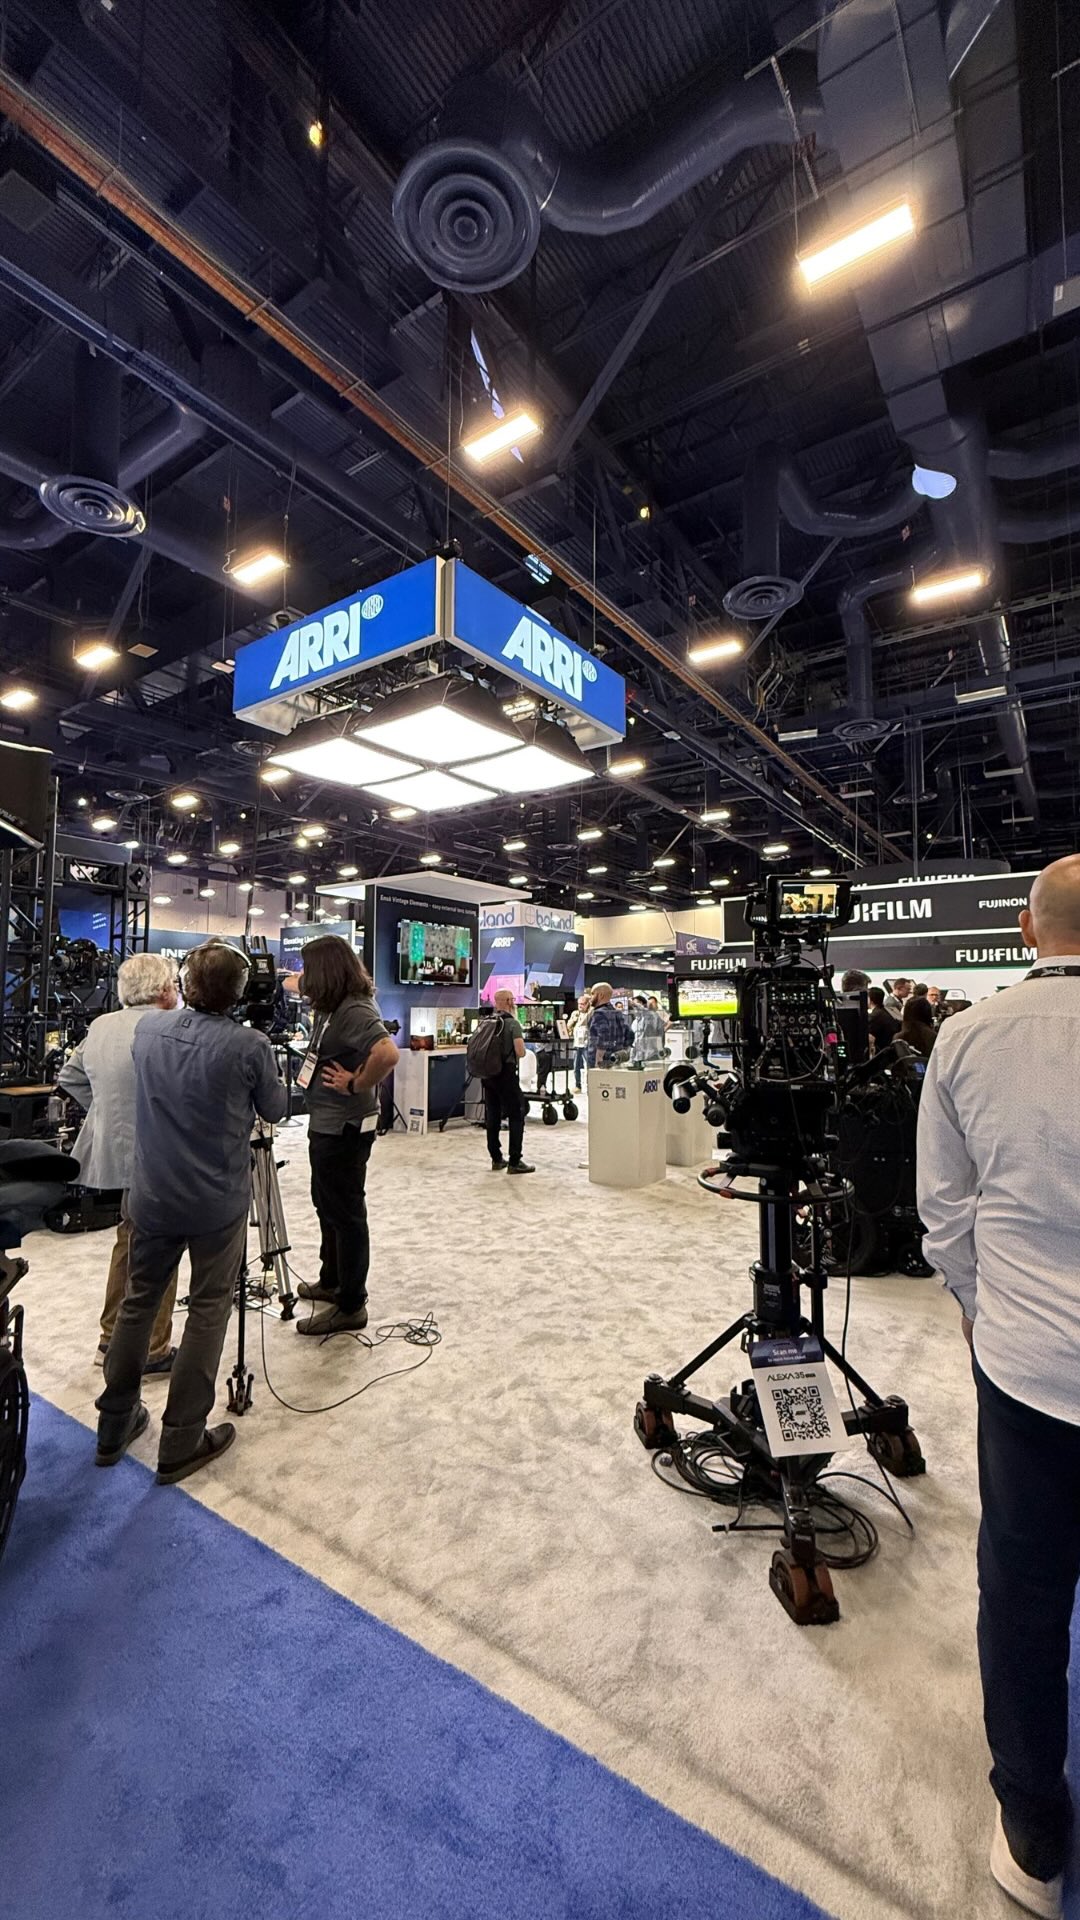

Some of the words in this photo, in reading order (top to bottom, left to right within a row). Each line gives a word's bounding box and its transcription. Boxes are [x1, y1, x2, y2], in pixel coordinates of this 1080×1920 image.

[269, 601, 361, 690] ARRI
[501, 615, 583, 702] ARRI
[848, 898, 932, 923] JIFILM
[978, 898, 1028, 909] FUJINON
[480, 906, 515, 928] land
[491, 937, 512, 948] ARRI
[955, 947, 1038, 963] FUJIFILM
[690, 958, 747, 971] FUJIFILM
[643, 1079, 658, 1094] ARRI
